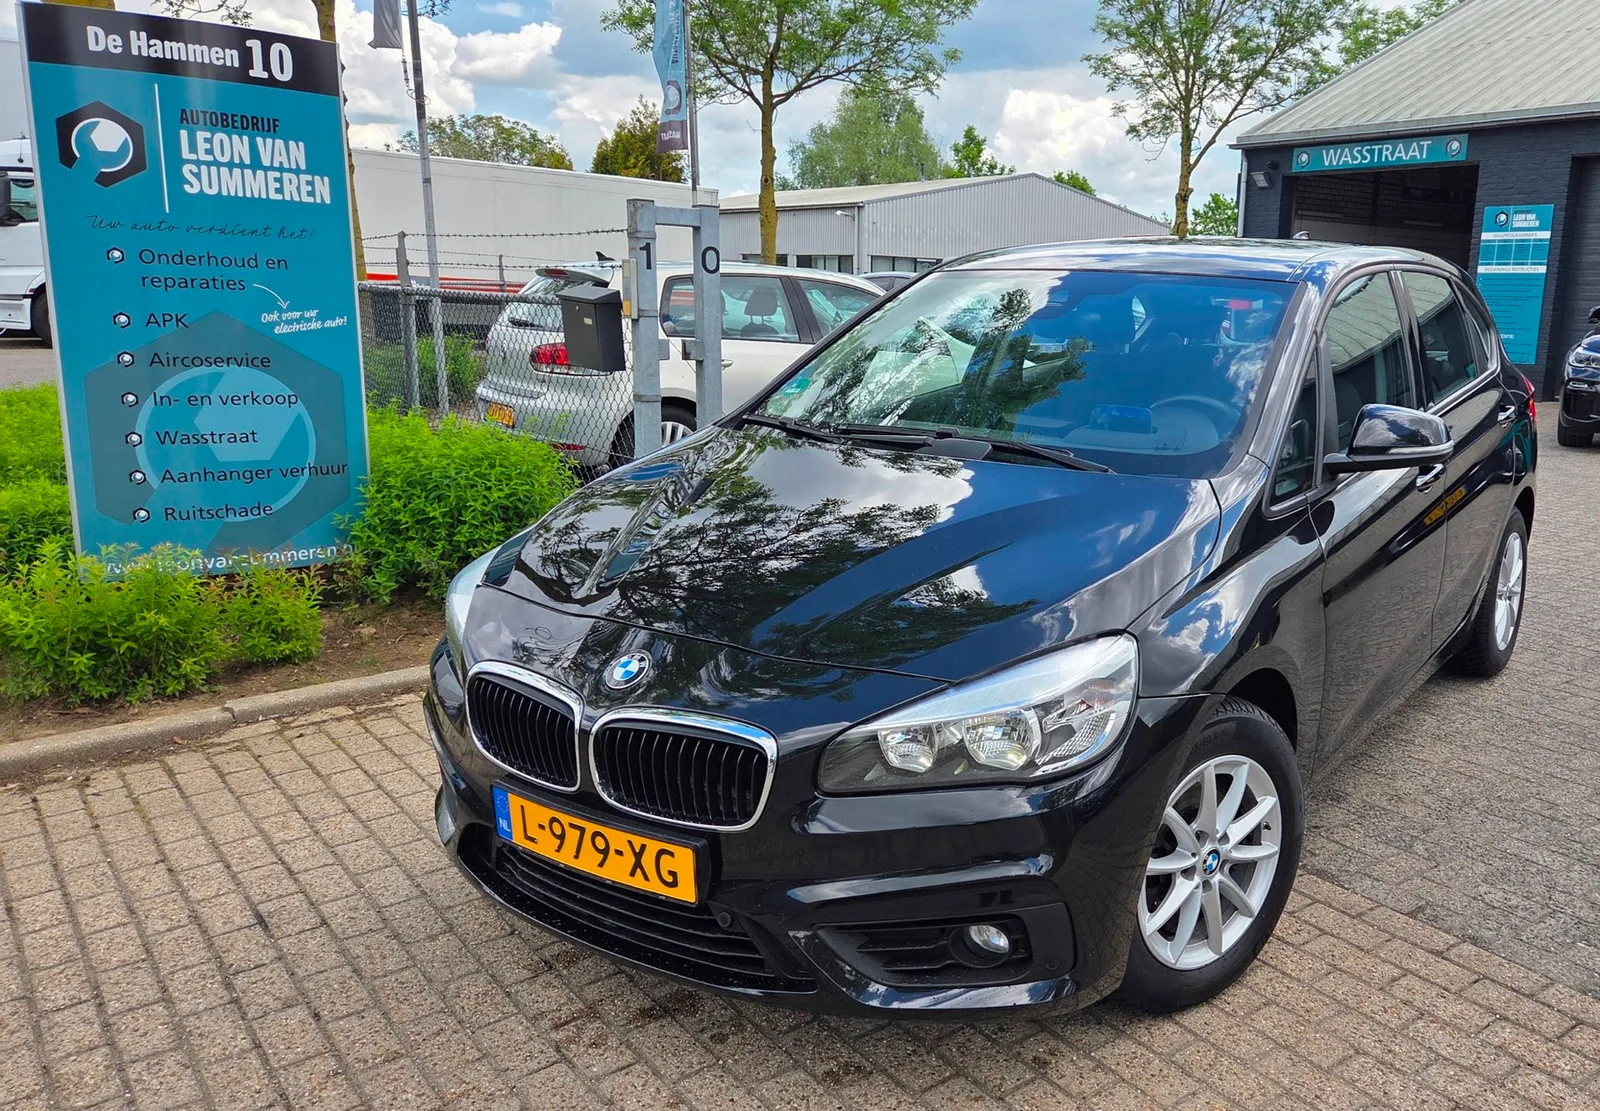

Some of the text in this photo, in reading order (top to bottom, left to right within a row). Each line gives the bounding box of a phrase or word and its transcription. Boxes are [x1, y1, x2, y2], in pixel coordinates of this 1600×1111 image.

[86, 25, 293, 82] De Hammen 10
[179, 108, 280, 134] AUTOBEDRIJF
[179, 130, 306, 170] LEON VAN
[1323, 141, 1432, 166] WASSTRAAT
[181, 164, 331, 204] SUMMEREN
[87, 214, 317, 240] Uw auto verdient het!
[139, 249, 288, 271] Onderhoud en
[639, 242, 720, 274] 1 0
[141, 274, 246, 292] reparaties
[145, 313, 189, 328] APK
[261, 309, 319, 323] Ook voor uw
[274, 316, 347, 334] electrische auto!
[149, 352, 271, 369] Aircoservice
[152, 391, 298, 408] In- en verkoop
[155, 430, 258, 446] Wasstraat
[160, 462, 348, 484] Aanhanger verhuur
[164, 502, 273, 521] Ruitschade
[498, 816, 511, 832] NL
[520, 804, 679, 888] L-979-XG
